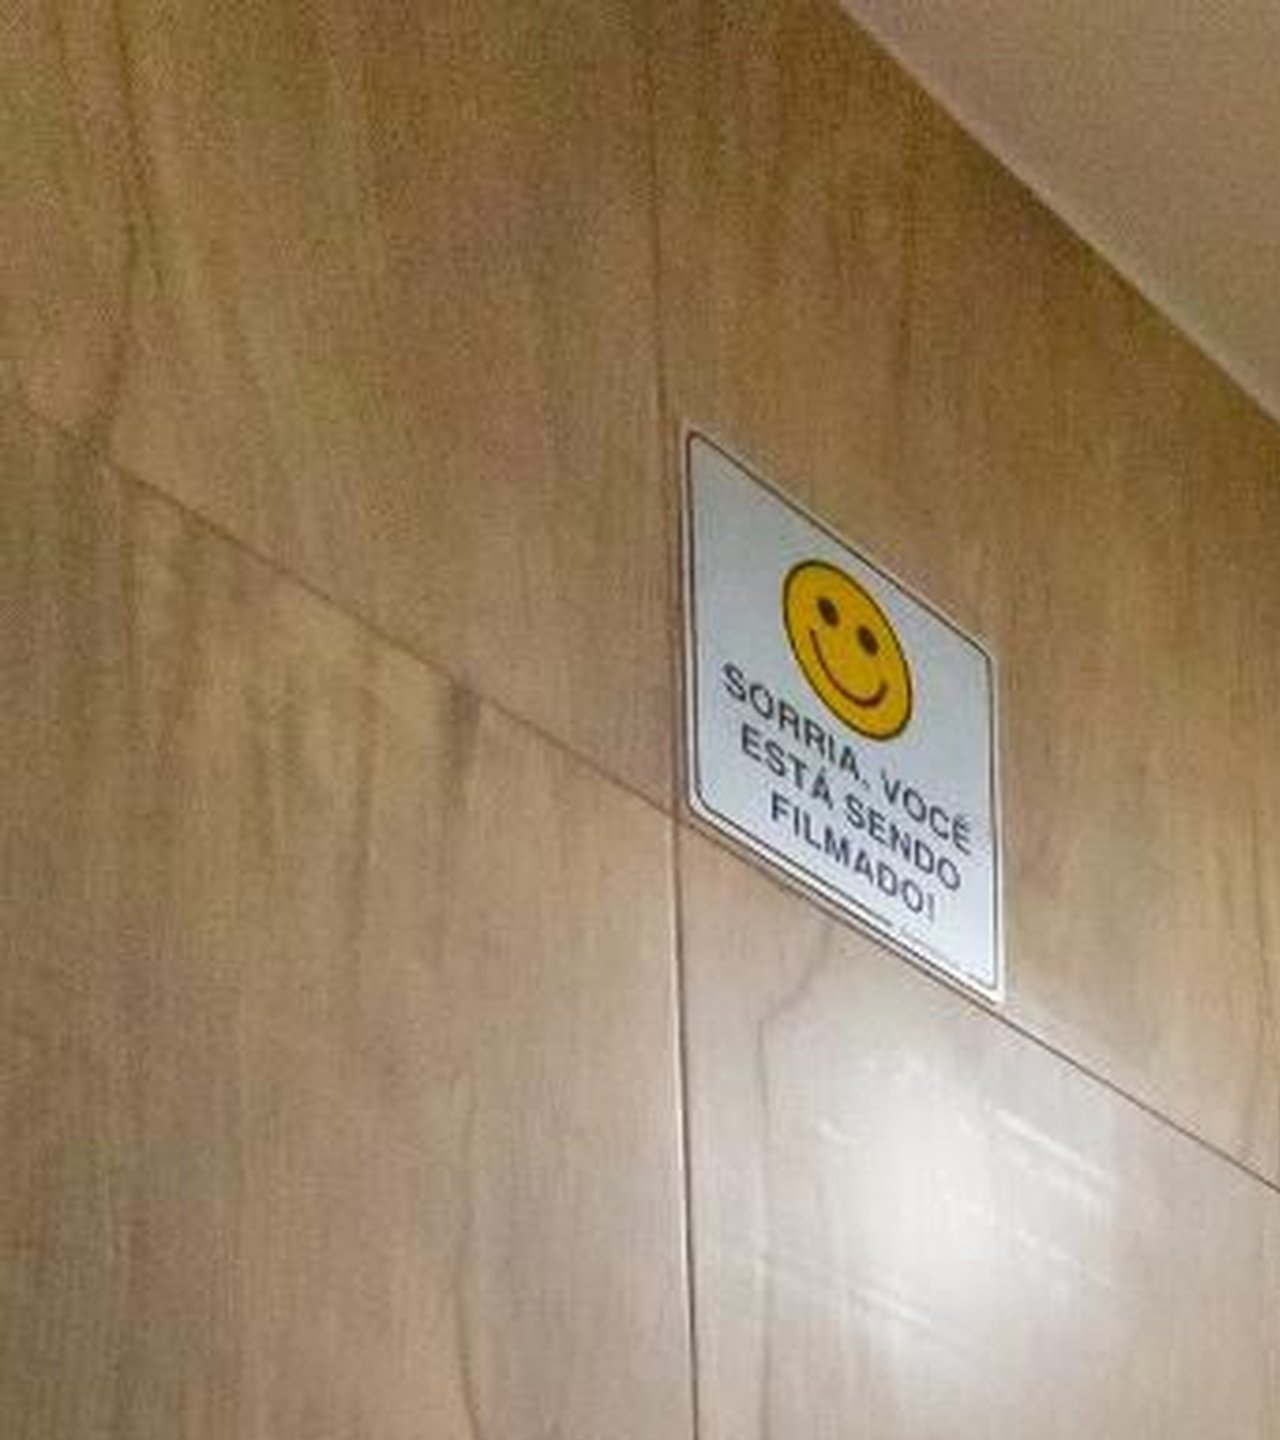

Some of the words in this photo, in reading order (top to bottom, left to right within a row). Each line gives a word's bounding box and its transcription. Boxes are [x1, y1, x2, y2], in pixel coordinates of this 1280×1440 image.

[722, 663, 872, 790] SORRIA,
[881, 765, 972, 855] VOCÊ
[741, 723, 832, 812] ESTÁ
[847, 791, 962, 891] SENDO
[771, 791, 937, 923] FILMADO!
